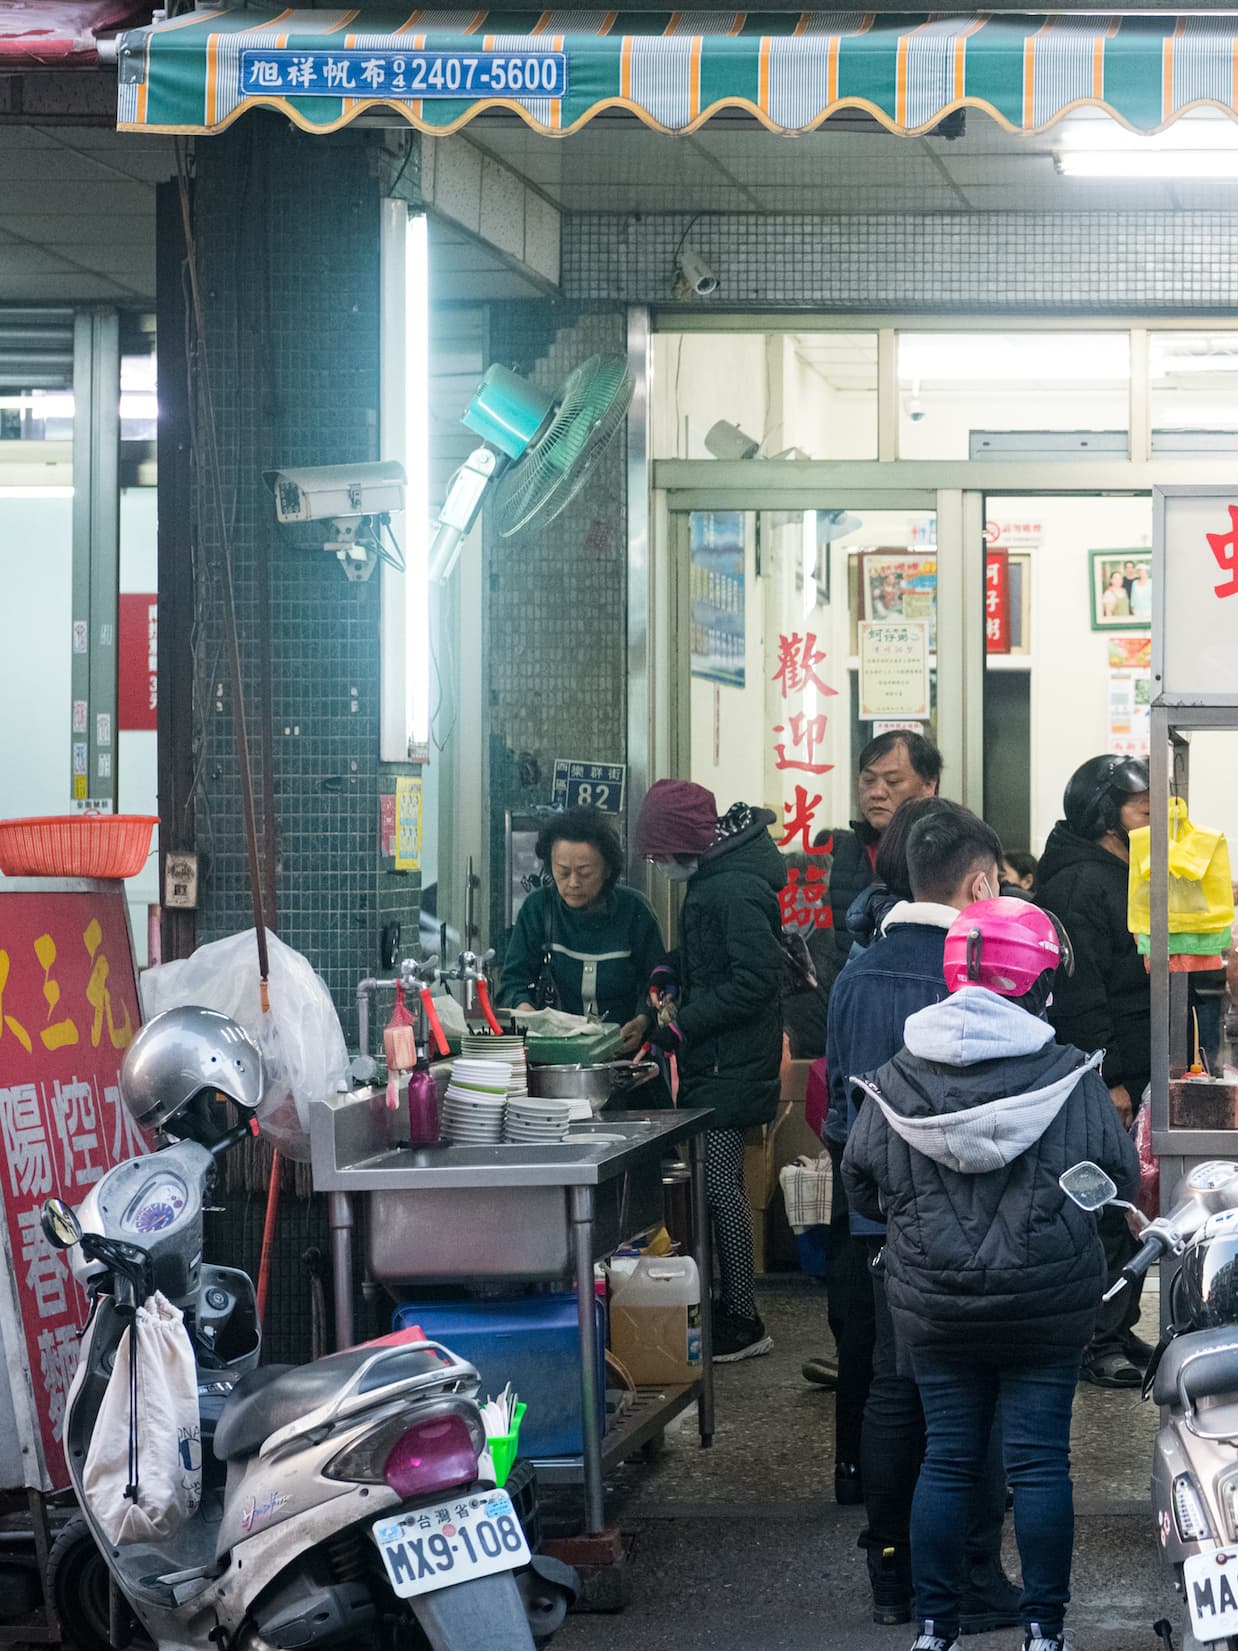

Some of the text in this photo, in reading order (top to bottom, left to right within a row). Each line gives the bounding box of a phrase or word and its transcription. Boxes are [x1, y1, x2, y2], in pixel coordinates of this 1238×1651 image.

[250, 57, 387, 88] 旭祥帆布
[411, 58, 557, 90] 2407-5600
[577, 783, 610, 810] 82
[772, 631, 840, 929] 歡迎光臨
